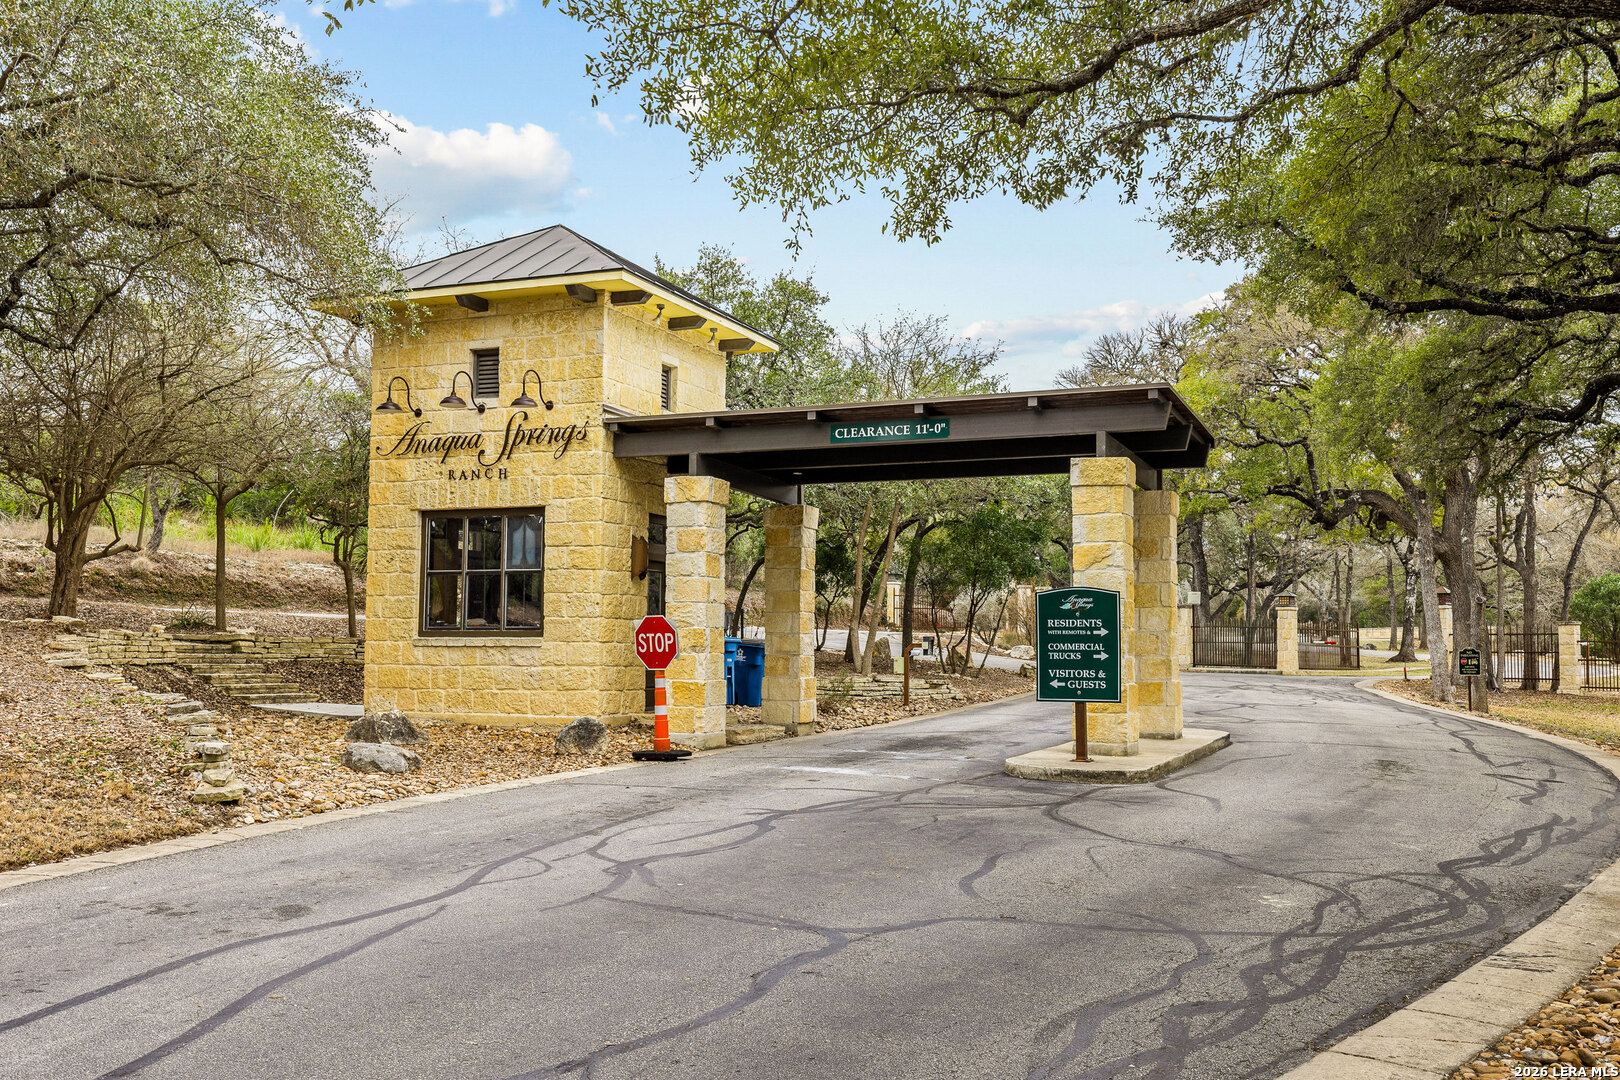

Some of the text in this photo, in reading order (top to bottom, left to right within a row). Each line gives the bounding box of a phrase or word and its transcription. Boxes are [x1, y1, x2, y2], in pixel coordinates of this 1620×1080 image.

[834, 423, 946, 439] CLEARANCE 11'-0"
[375, 410, 590, 467] Anaqua Springs
[448, 468, 508, 480] RANCH
[1047, 619, 1103, 627] RESIDENTS
[638, 632, 674, 653] STOP
[1047, 643, 1105, 651] COMMERCIAL
[1048, 652, 1081, 660] TRUCKS
[1048, 669, 1106, 678] VISITORS &
[1067, 680, 1107, 689] GUESTS
